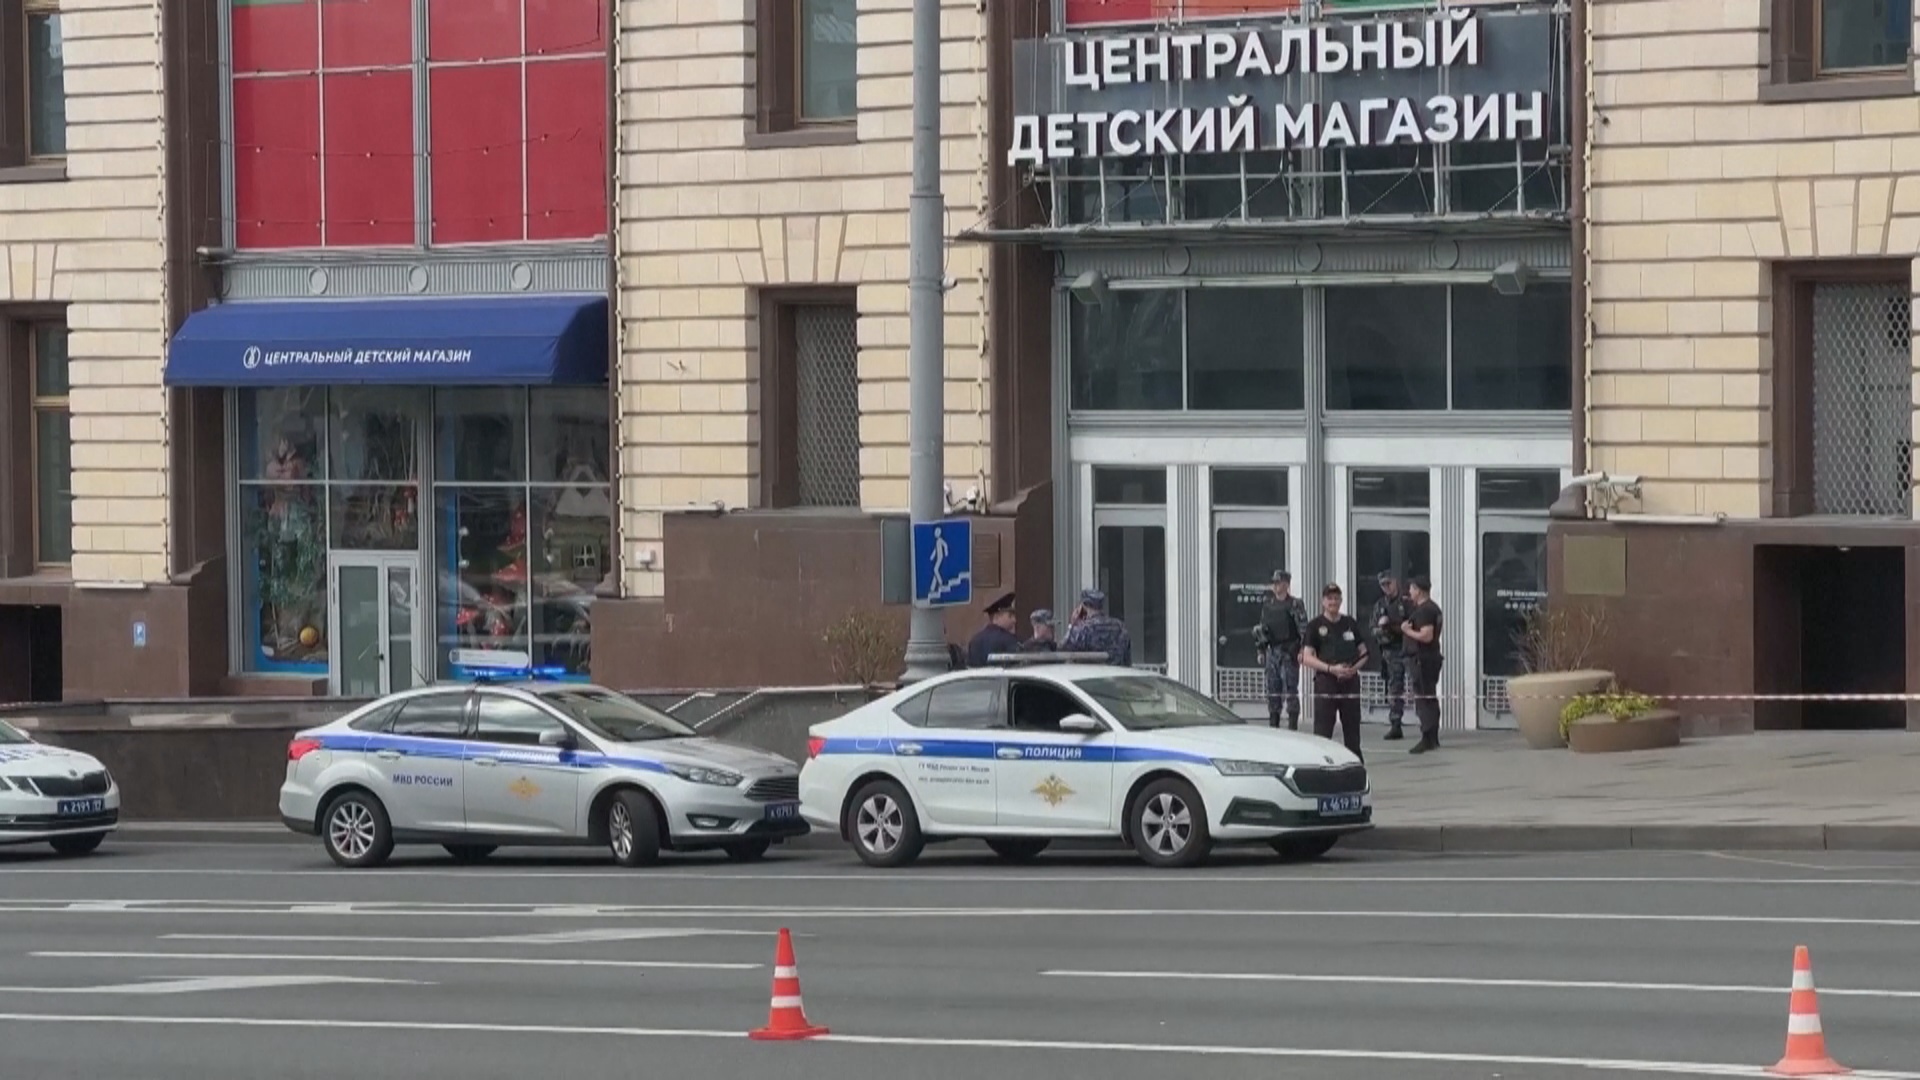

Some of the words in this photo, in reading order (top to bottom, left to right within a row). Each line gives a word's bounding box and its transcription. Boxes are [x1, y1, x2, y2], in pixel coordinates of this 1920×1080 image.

[1065, 8, 1479, 90] ЦЕНТРАЛЬНЫЙ
[1008, 94, 1256, 166] ДЕТСКИЙ
[1276, 91, 1544, 149] МАГАЗИН
[264, 347, 353, 366] ЦЕНТРАЛЬНЫЙ
[354, 347, 411, 365] ДЕТСКИЙ
[413, 349, 472, 363] МАГАЗИН
[1024, 746, 1082, 759] ПОЛИЦИЯ
[393, 773, 413, 784] МВД
[414, 775, 453, 787] РОССИИ
